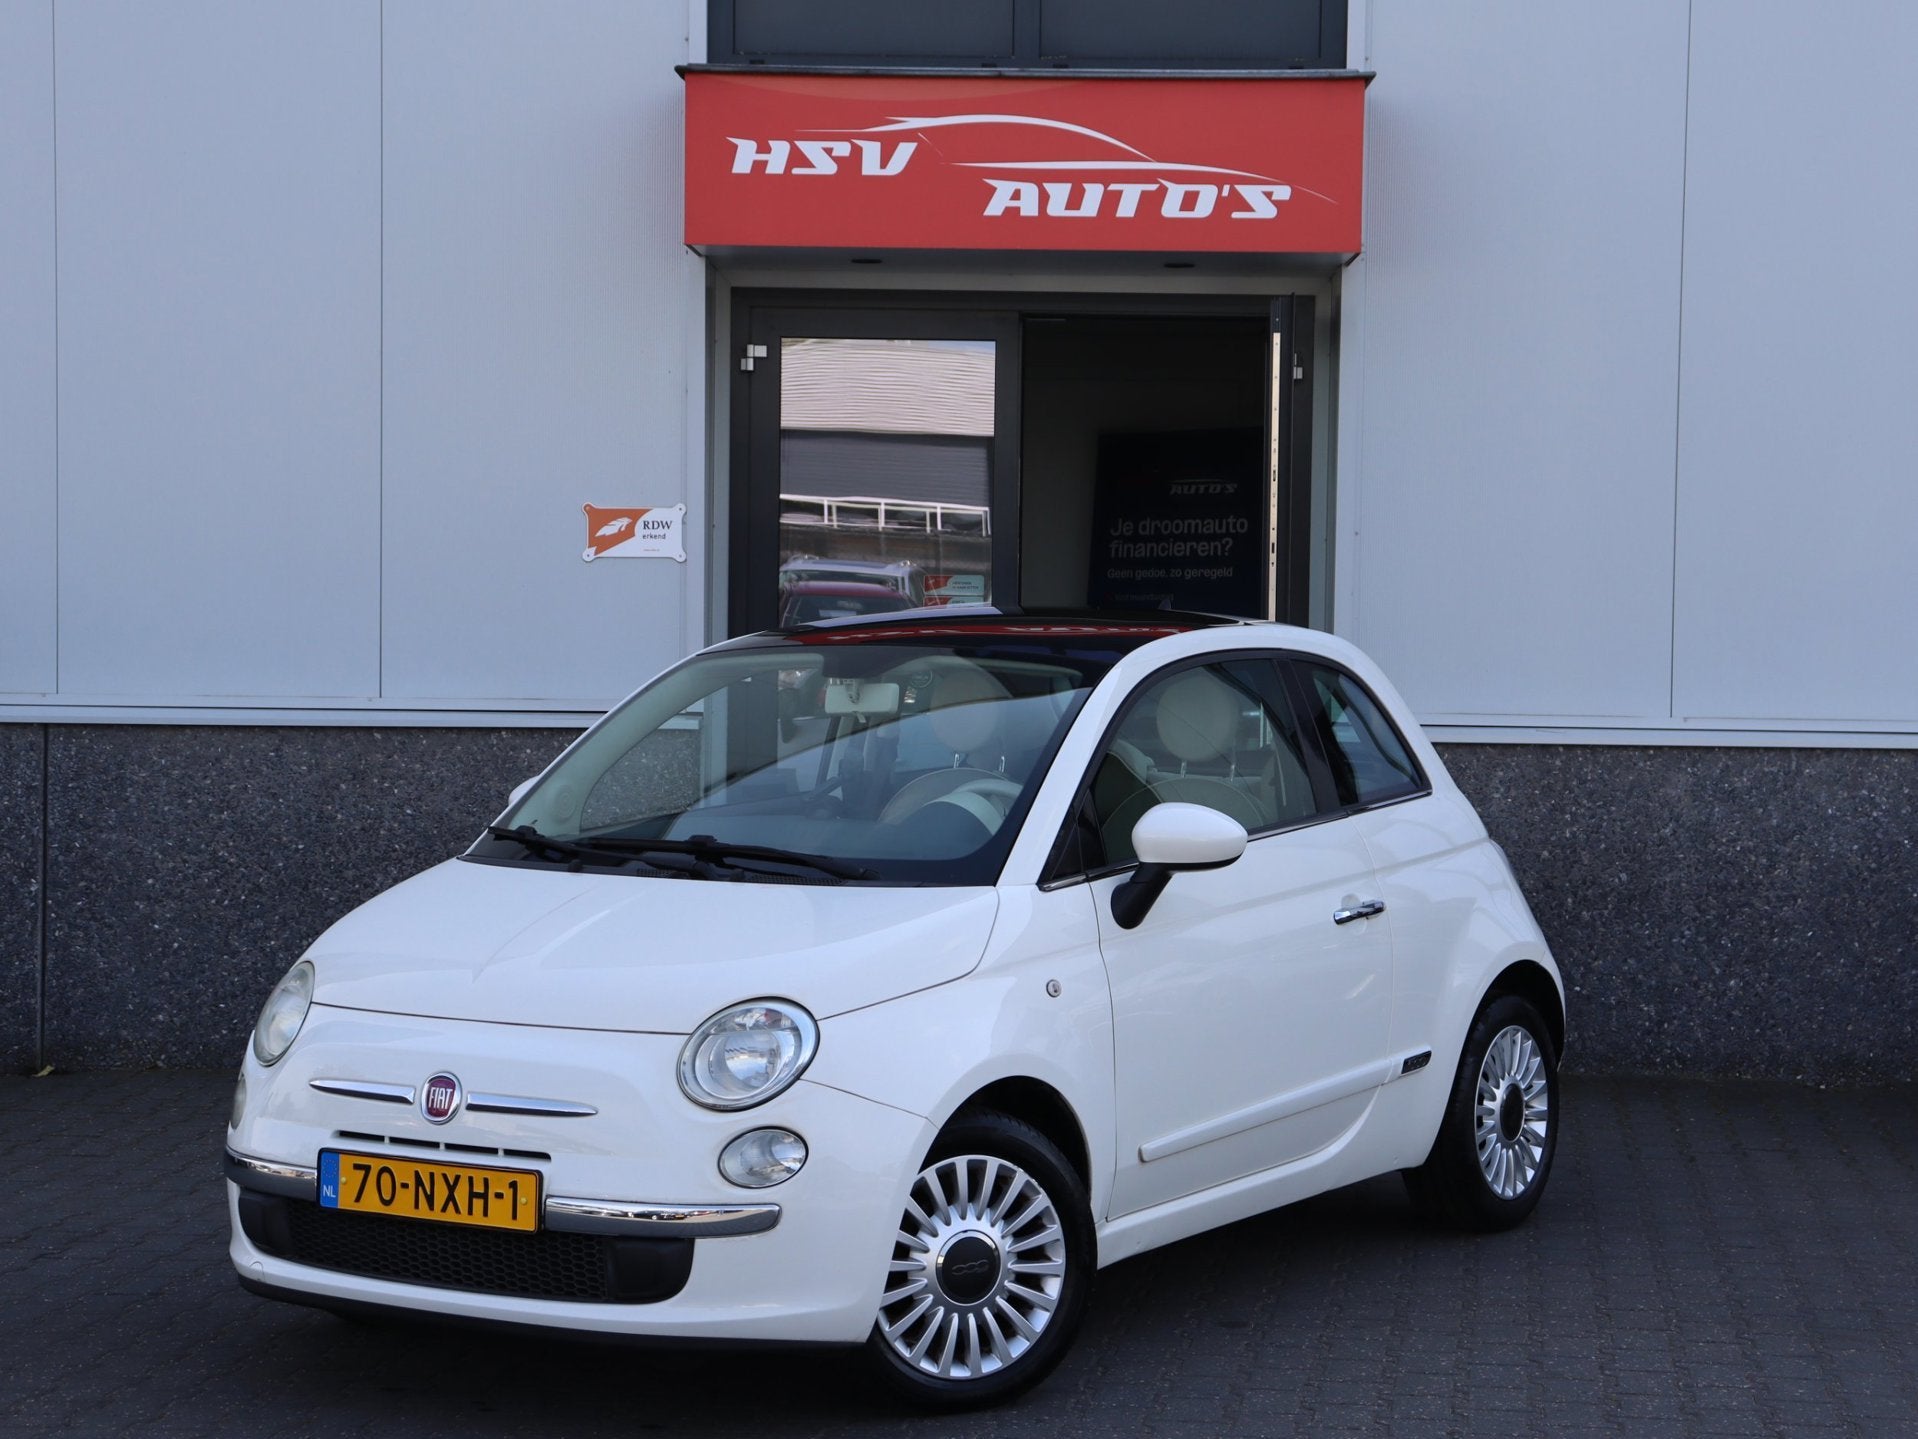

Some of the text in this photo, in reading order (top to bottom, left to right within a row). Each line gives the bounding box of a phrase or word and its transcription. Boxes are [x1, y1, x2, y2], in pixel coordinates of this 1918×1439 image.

[725, 137, 917, 176] HSV
[982, 179, 1292, 219] AUTO'S
[643, 520, 672, 530] RDW
[1110, 515, 1248, 536] Je droomauto
[642, 532, 666, 540] erkend
[1109, 537, 1233, 558] financieren?
[1107, 568, 1133, 579] Geen
[1170, 567, 1183, 577] zo
[1184, 566, 1233, 579] geregeld
[428, 1087, 453, 1110] FIAT
[322, 1184, 337, 1198] NL
[352, 1163, 519, 1221] 70-NXH-1
